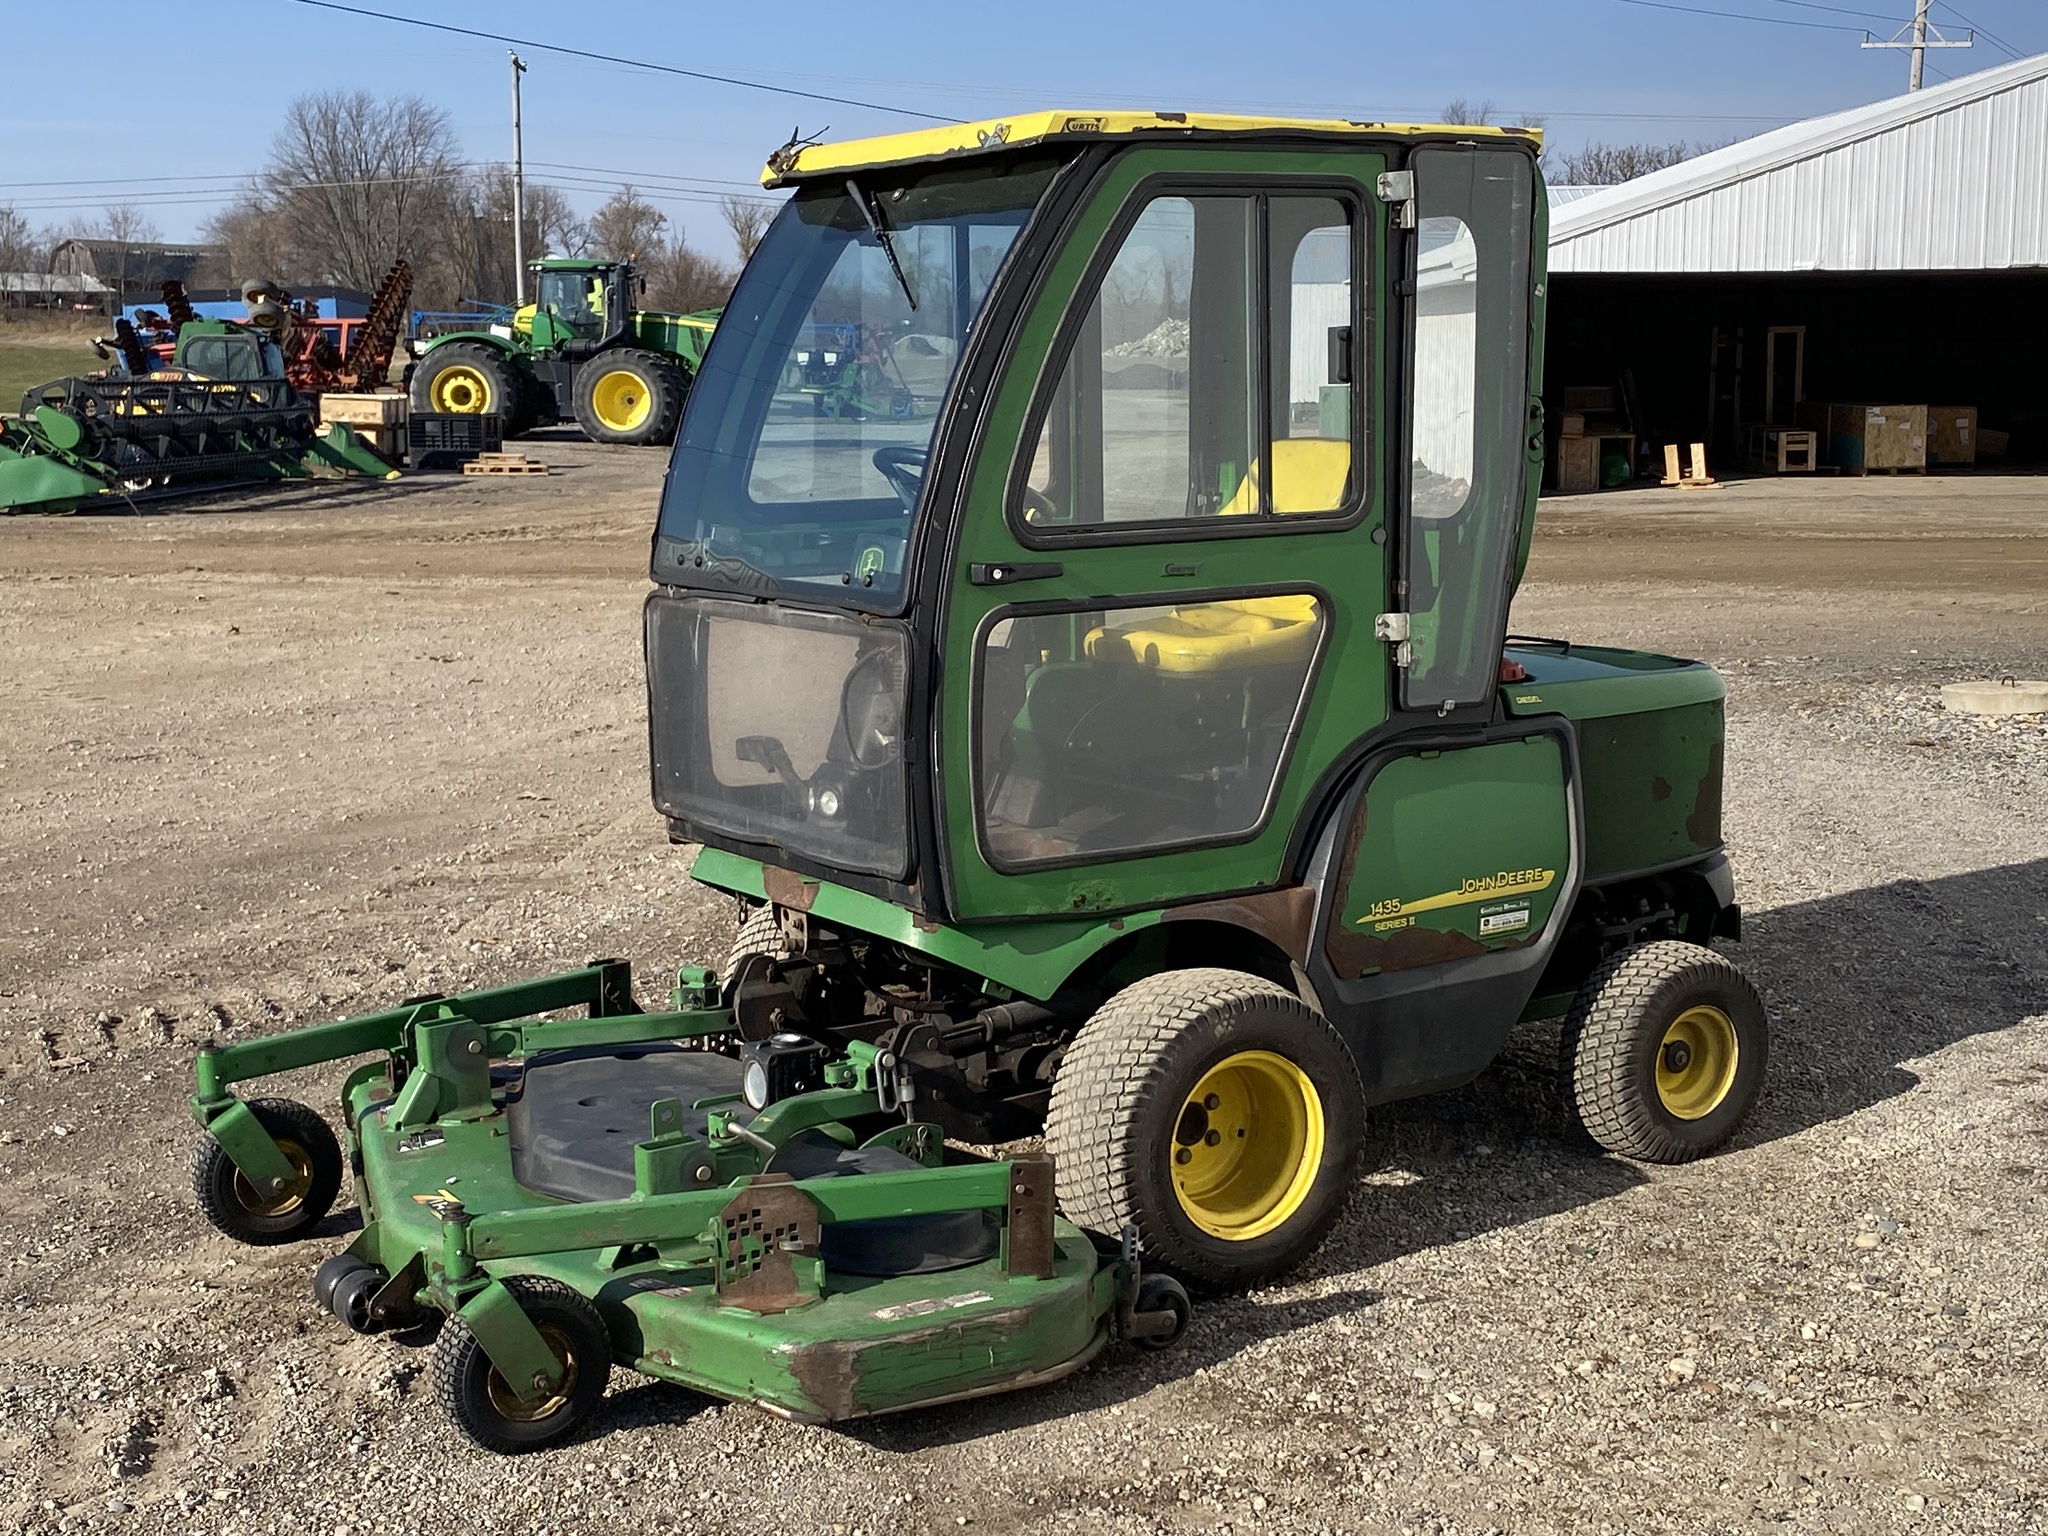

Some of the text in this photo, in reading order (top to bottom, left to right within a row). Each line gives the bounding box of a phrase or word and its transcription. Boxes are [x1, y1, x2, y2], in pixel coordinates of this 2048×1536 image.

[1066, 117, 1101, 132] CURTIS
[1457, 867, 1544, 895] JOHN DEERE
[1370, 897, 1402, 916] 1435
[1374, 915, 1416, 932] SERIES II
